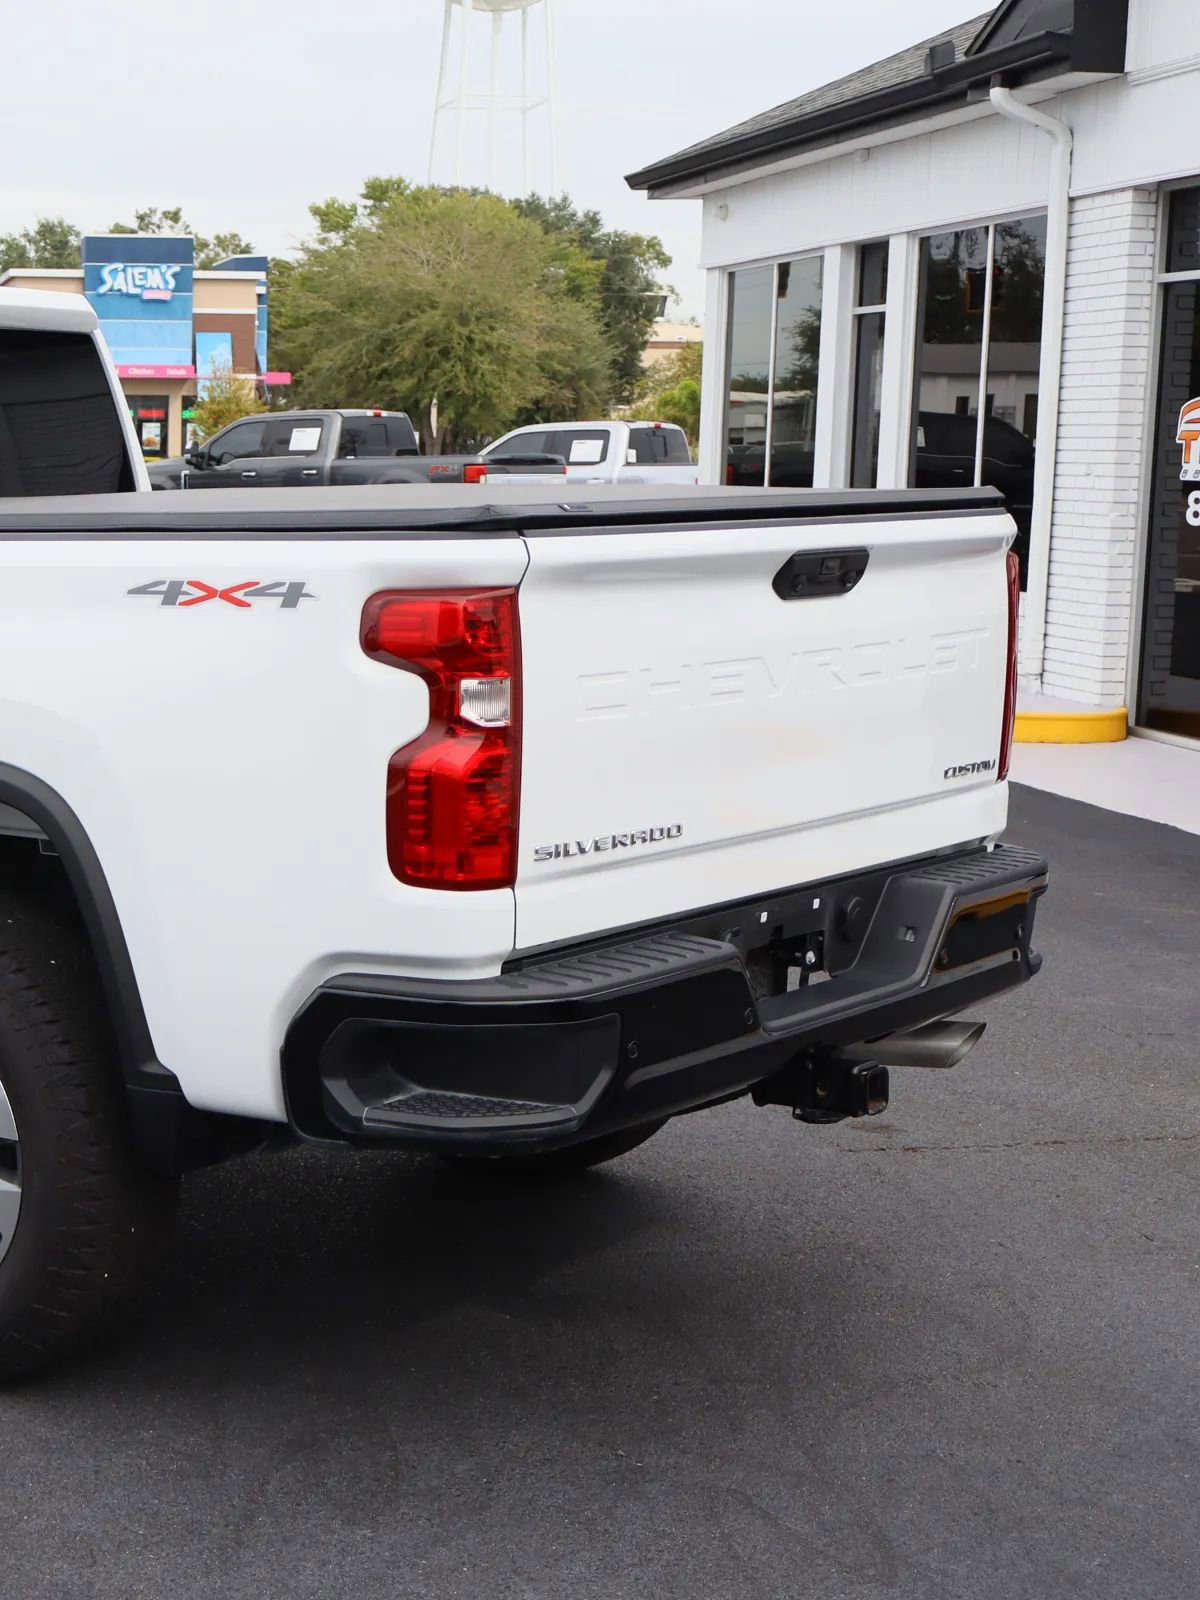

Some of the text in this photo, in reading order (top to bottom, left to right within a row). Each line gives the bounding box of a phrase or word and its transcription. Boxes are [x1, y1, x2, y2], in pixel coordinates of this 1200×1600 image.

[576, 626, 990, 723] CHEVROLET
[943, 759, 996, 779] CUSTOM
[533, 823, 683, 862] SILVERADO
